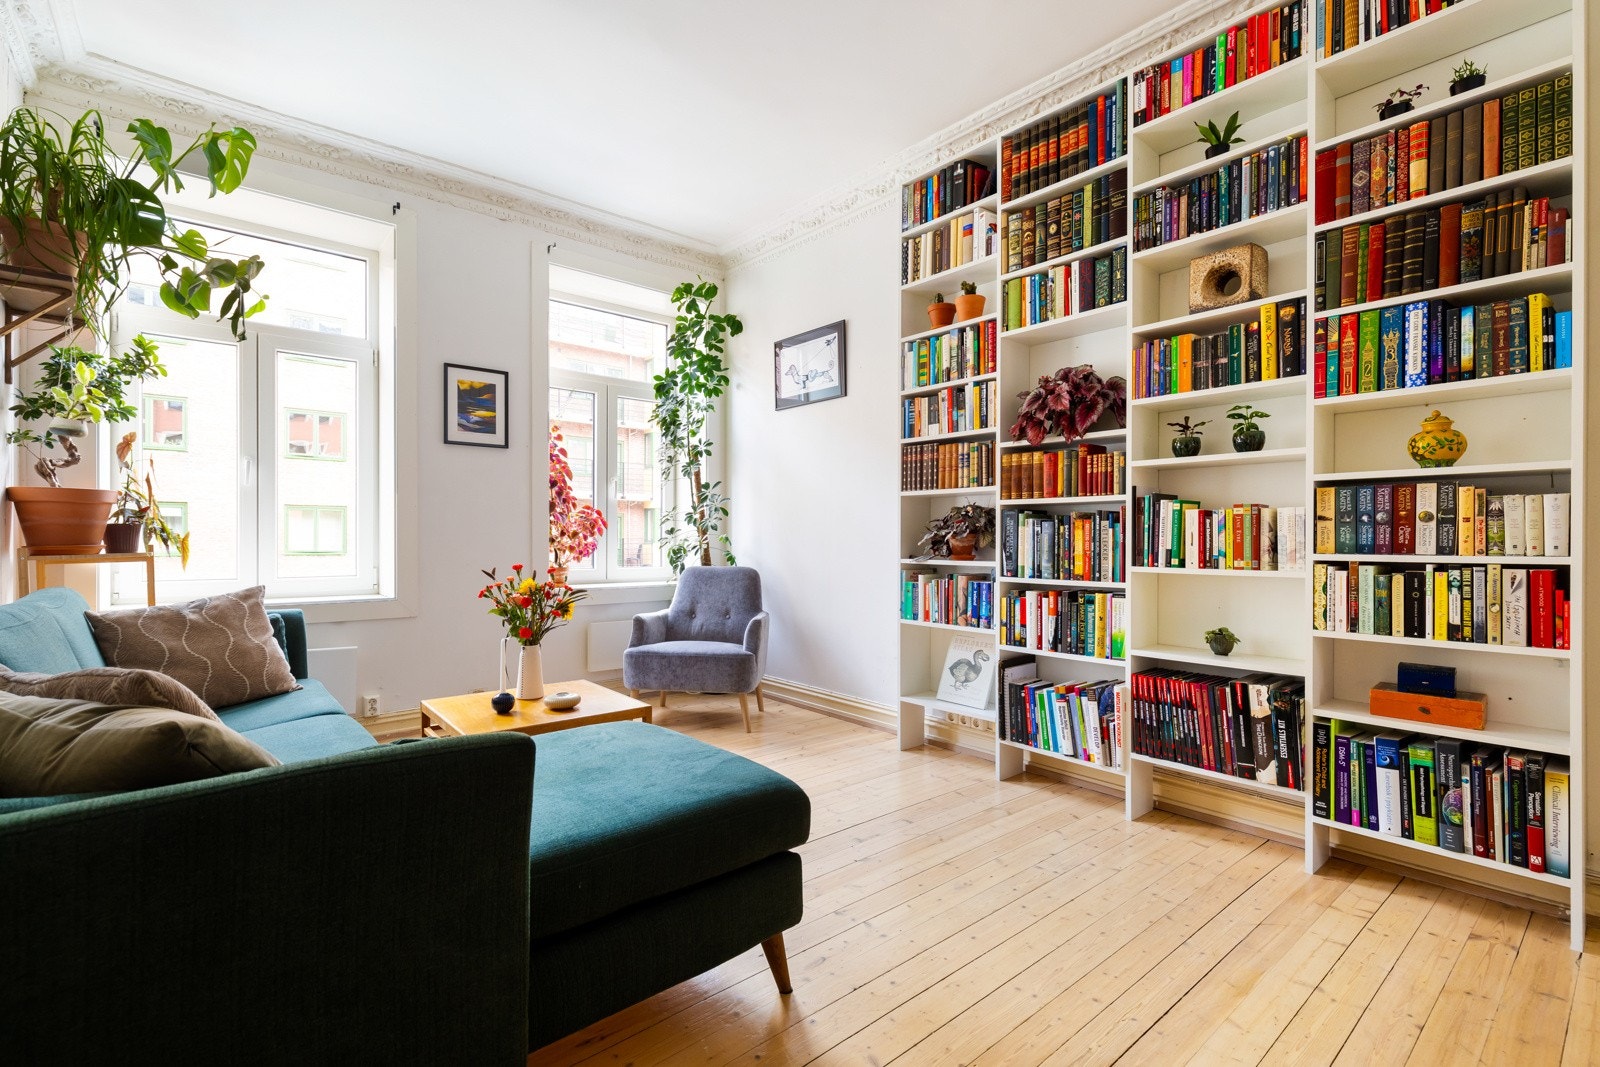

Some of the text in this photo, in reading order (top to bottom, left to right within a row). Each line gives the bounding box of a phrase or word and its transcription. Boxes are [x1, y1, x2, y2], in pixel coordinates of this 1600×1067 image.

[1283, 327, 1293, 356] NARNIA
[1377, 488, 1385, 511] MARTIN
[1398, 487, 1406, 511] MARTIN
[1440, 485, 1448, 509] MARTIN
[1092, 726, 1100, 749] DEVELOP
[1256, 732, 1264, 756] DUNGEON
[1278, 719, 1288, 759] ESSENTIALS KIT
[1439, 752, 1447, 783] Assessment
[1512, 779, 1520, 800] Cognitive
[1384, 800, 1393, 825] psykiatri
[1534, 791, 1542, 816] Sensation
[1550, 785, 1561, 849] Clinical Interviewing
